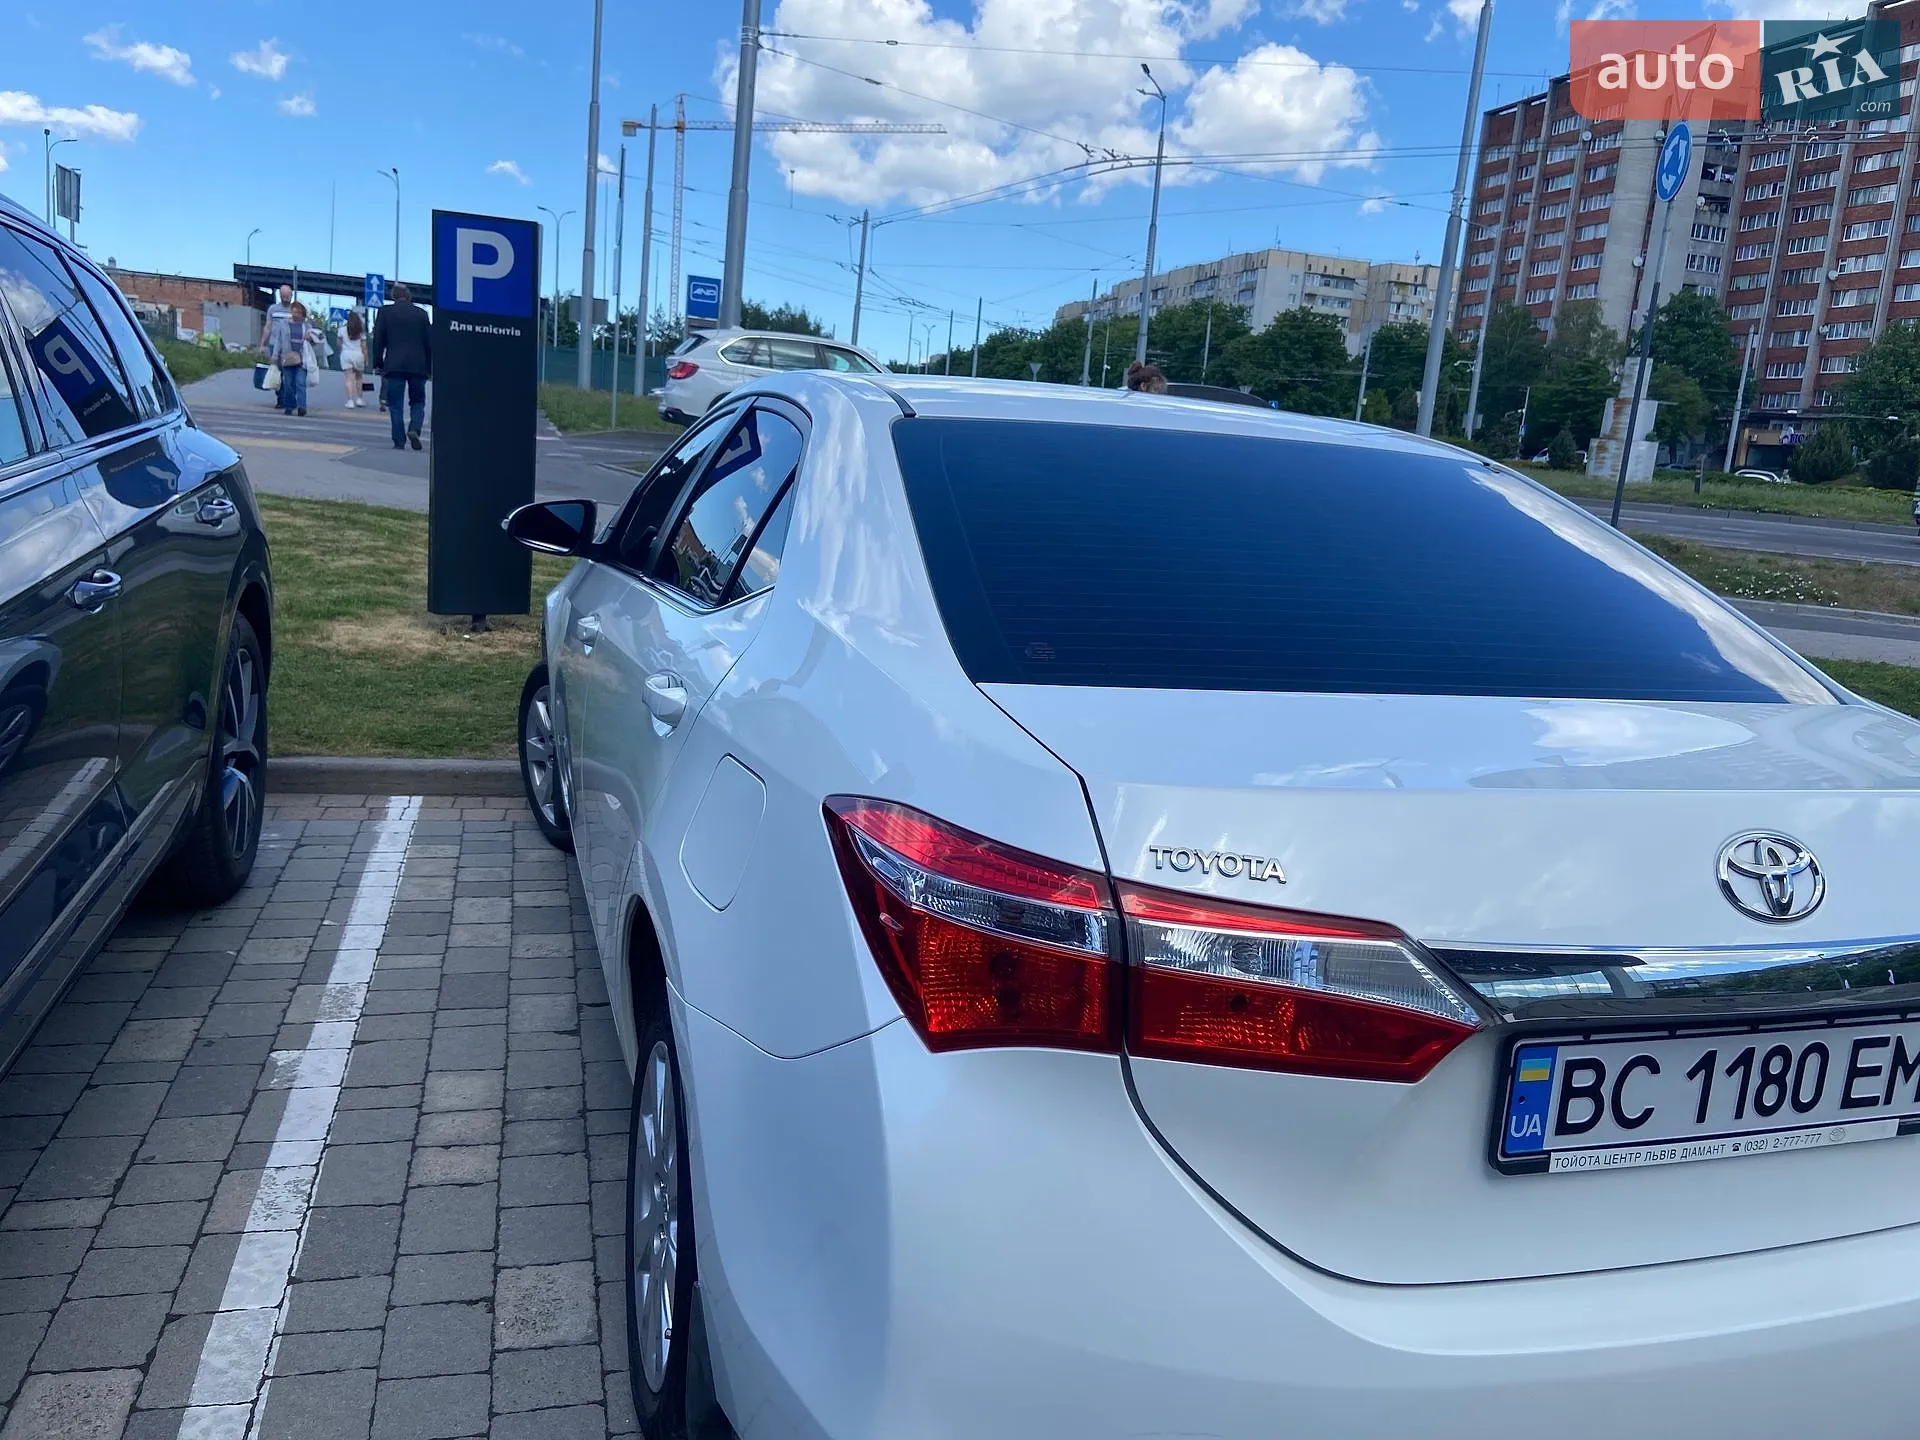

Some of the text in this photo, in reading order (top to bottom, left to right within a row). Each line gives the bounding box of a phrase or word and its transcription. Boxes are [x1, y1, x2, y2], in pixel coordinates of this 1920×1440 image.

[456, 227, 515, 303] P
[449, 320, 521, 337] Для клієнтів
[1149, 844, 1287, 884] TOYOTA
[1555, 1035, 1920, 1136] BC 1180 EM
[1510, 1114, 1542, 1138] UA
[1554, 1132, 1822, 1169] ТОЙОТА ЦЕНТР ЛЬВІВ ДІАМАНТ (032) 2-777-777
